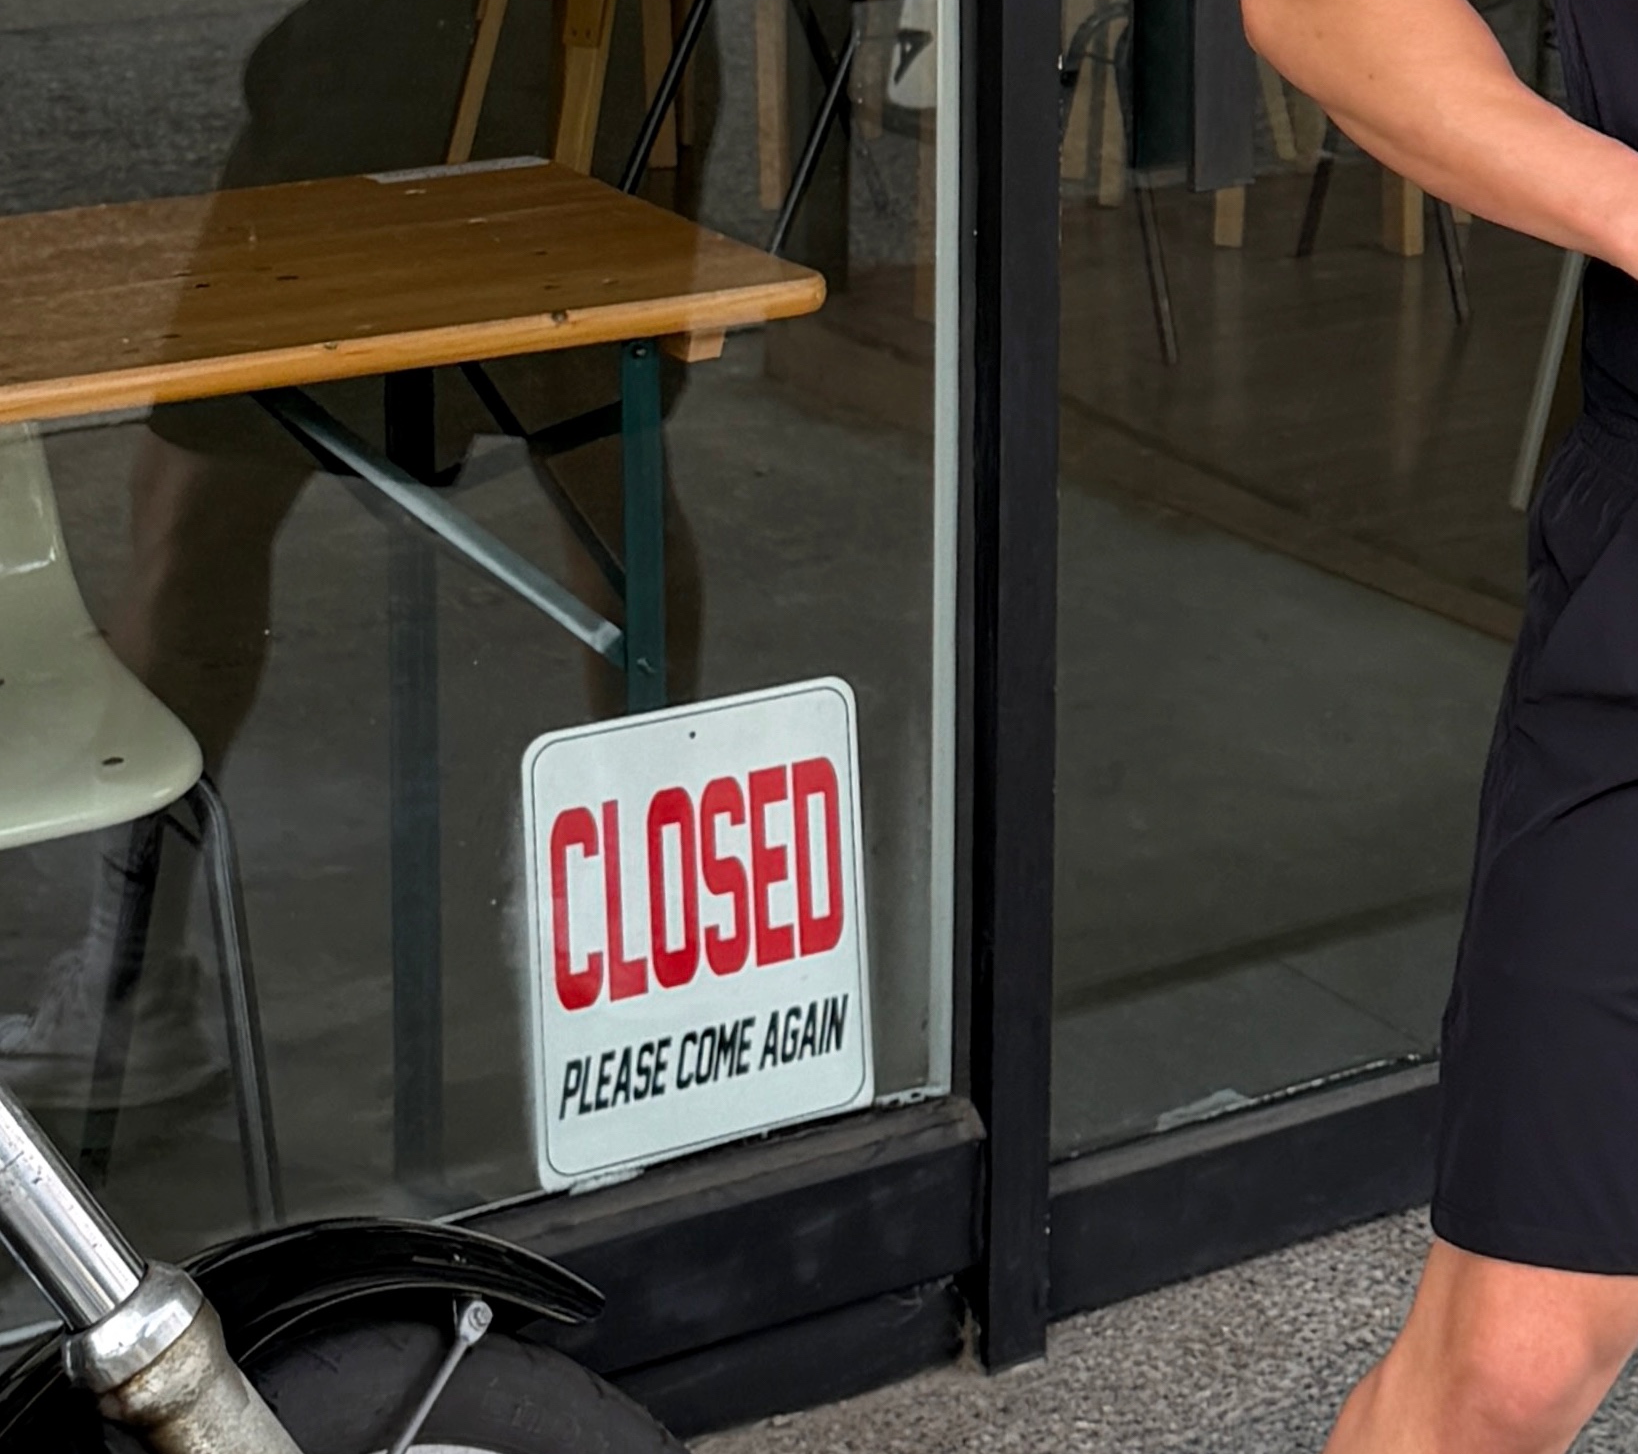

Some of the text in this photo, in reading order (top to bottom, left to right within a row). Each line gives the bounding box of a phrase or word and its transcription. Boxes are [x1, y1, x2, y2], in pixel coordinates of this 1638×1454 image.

[549, 756, 845, 1012] CLOSED
[559, 993, 850, 1121] PLEASE COME AGAIN
